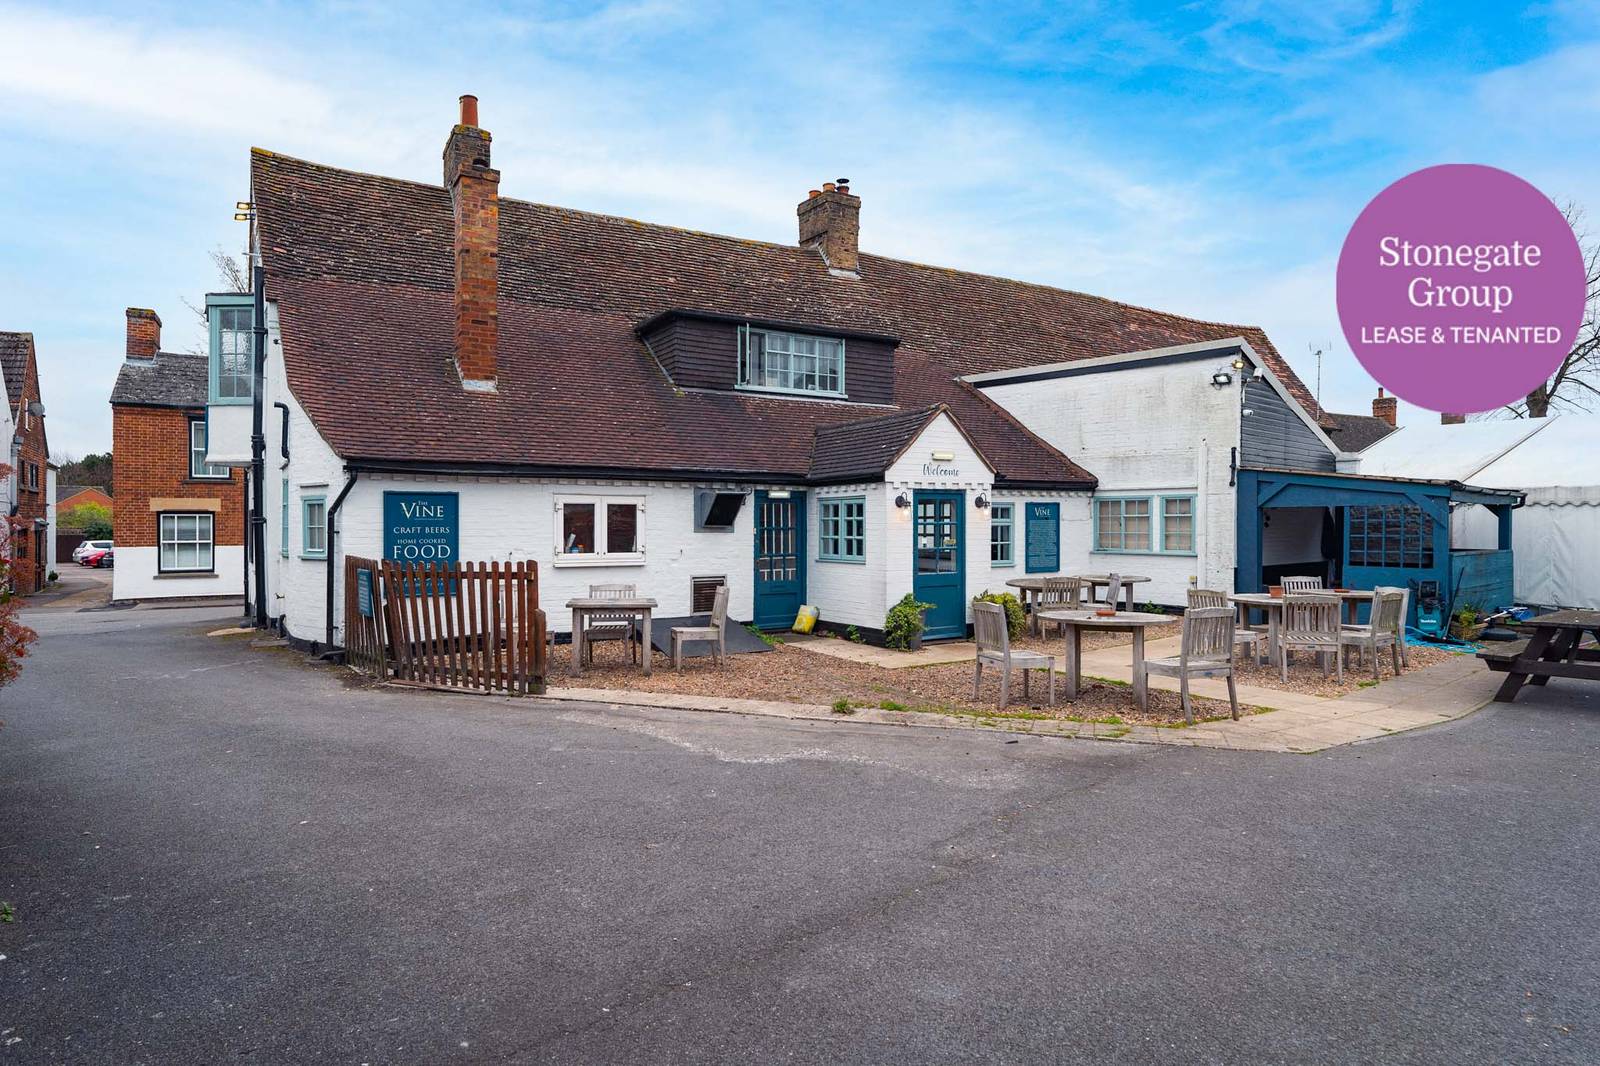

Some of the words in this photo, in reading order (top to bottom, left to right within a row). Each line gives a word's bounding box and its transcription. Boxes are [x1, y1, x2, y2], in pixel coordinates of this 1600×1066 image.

[922, 462, 959, 477] Welcome
[400, 502, 444, 519] VINE
[393, 545, 451, 559] FOOD
